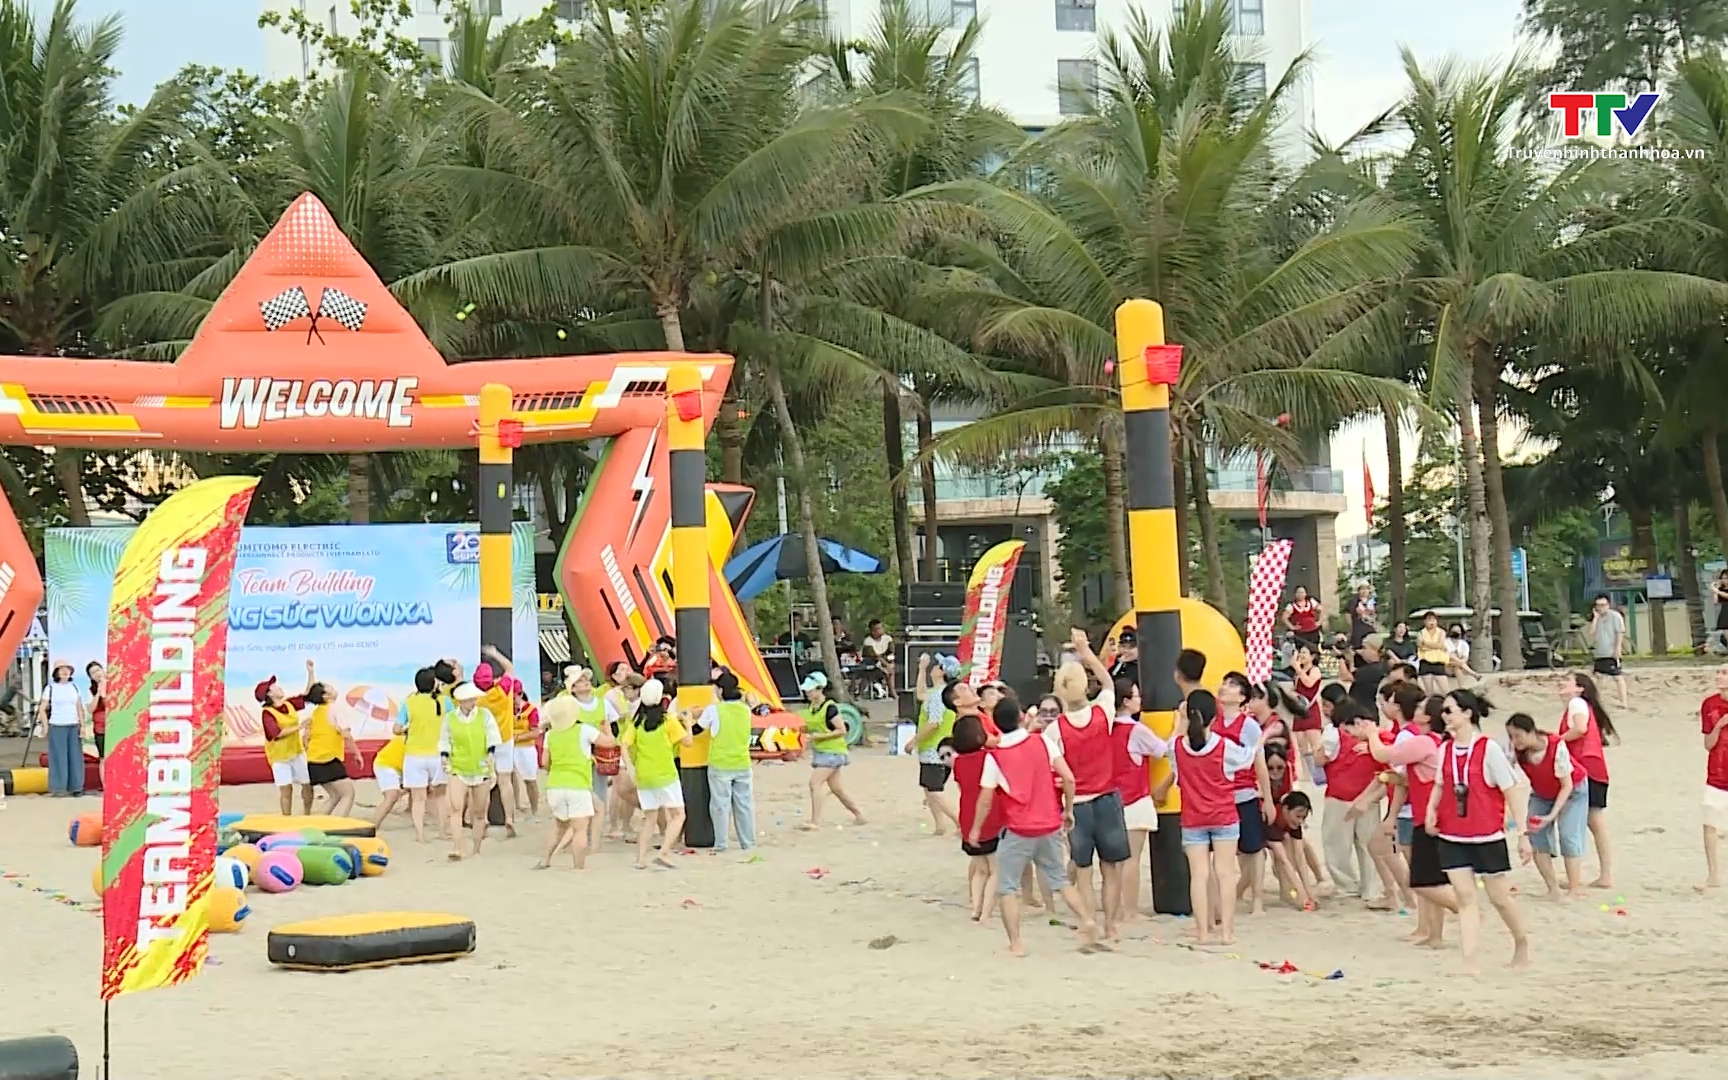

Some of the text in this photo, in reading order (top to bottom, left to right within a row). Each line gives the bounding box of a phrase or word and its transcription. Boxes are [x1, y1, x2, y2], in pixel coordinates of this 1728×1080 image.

[220, 376, 419, 430] WELCOME
[238, 541, 341, 551] UMITOMO ELECTRIC
[238, 567, 374, 598] Team Building
[394, 600, 432, 625] XA
[968, 565, 1005, 687] AMBUILDING
[136, 547, 208, 953] TEAMBUILDING
